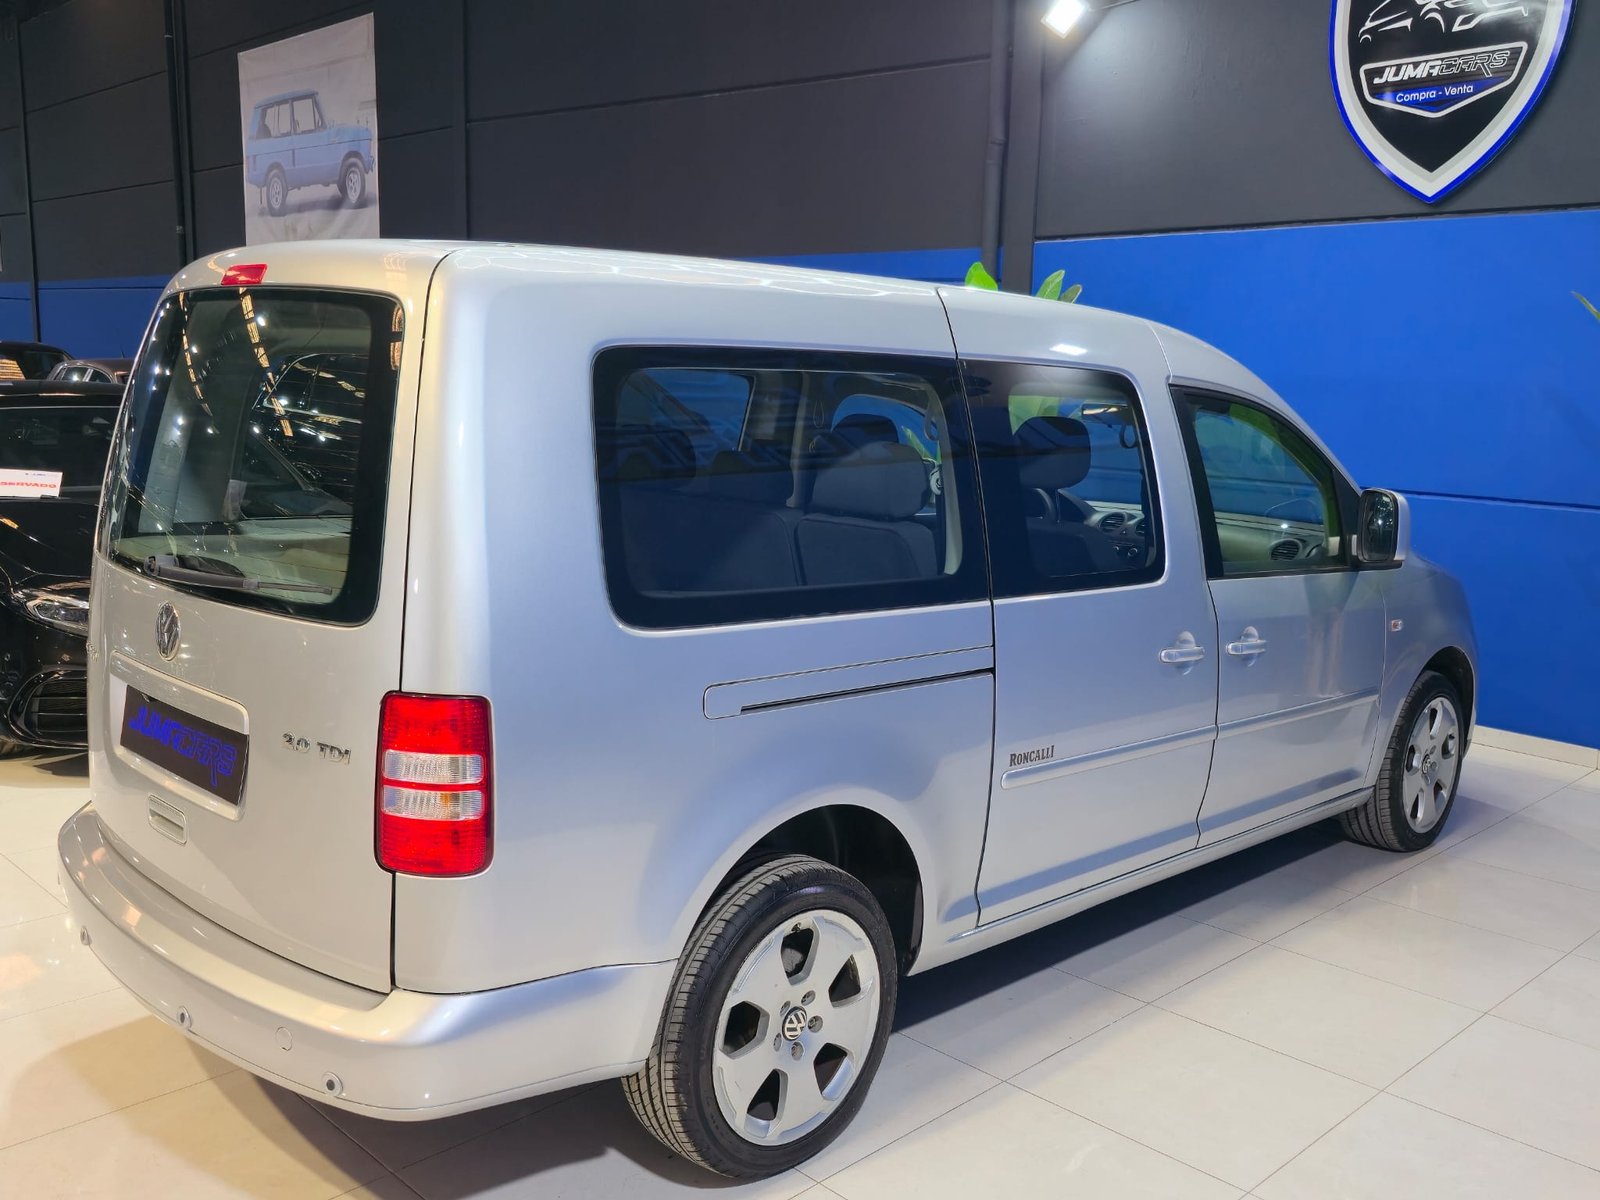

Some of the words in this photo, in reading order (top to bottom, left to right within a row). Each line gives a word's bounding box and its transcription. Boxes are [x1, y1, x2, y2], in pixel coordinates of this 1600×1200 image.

[1373, 51, 1510, 84] JUMACARS
[1395, 91, 1436, 103] Compra
[1444, 84, 1474, 97] Venta
[316, 741, 352, 766] TDI
[1009, 744, 1055, 767] RONCALLI
